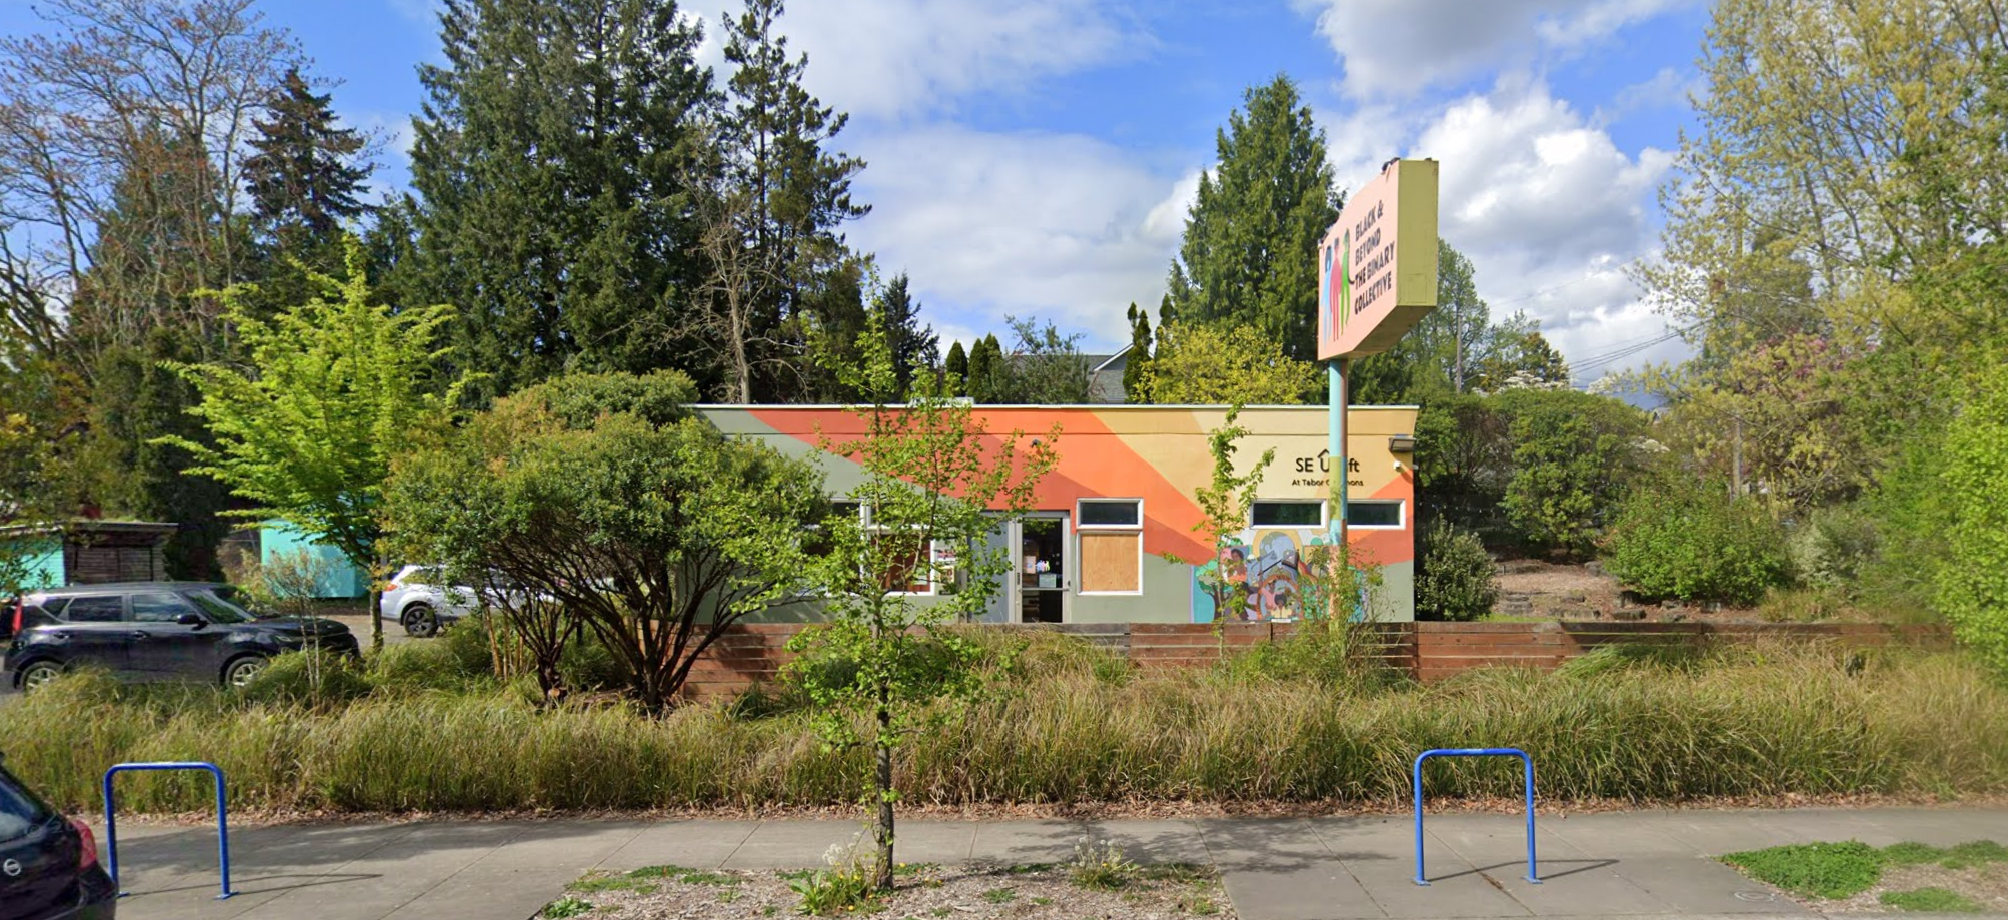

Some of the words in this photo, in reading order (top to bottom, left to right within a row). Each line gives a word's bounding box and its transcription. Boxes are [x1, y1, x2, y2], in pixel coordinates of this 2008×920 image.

[1355, 205, 1376, 242] BLACK
[1377, 199, 1384, 219] &
[1355, 227, 1381, 266] BEYOND
[1355, 266, 1366, 290] THE
[1367, 240, 1395, 281] BINARY
[1354, 270, 1392, 315] COLLECTIVE
[1291, 479, 1300, 487] At
[1302, 478, 1324, 487] Tabor
[1295, 457, 1314, 473] SE
[1320, 457, 1360, 473] Uft
